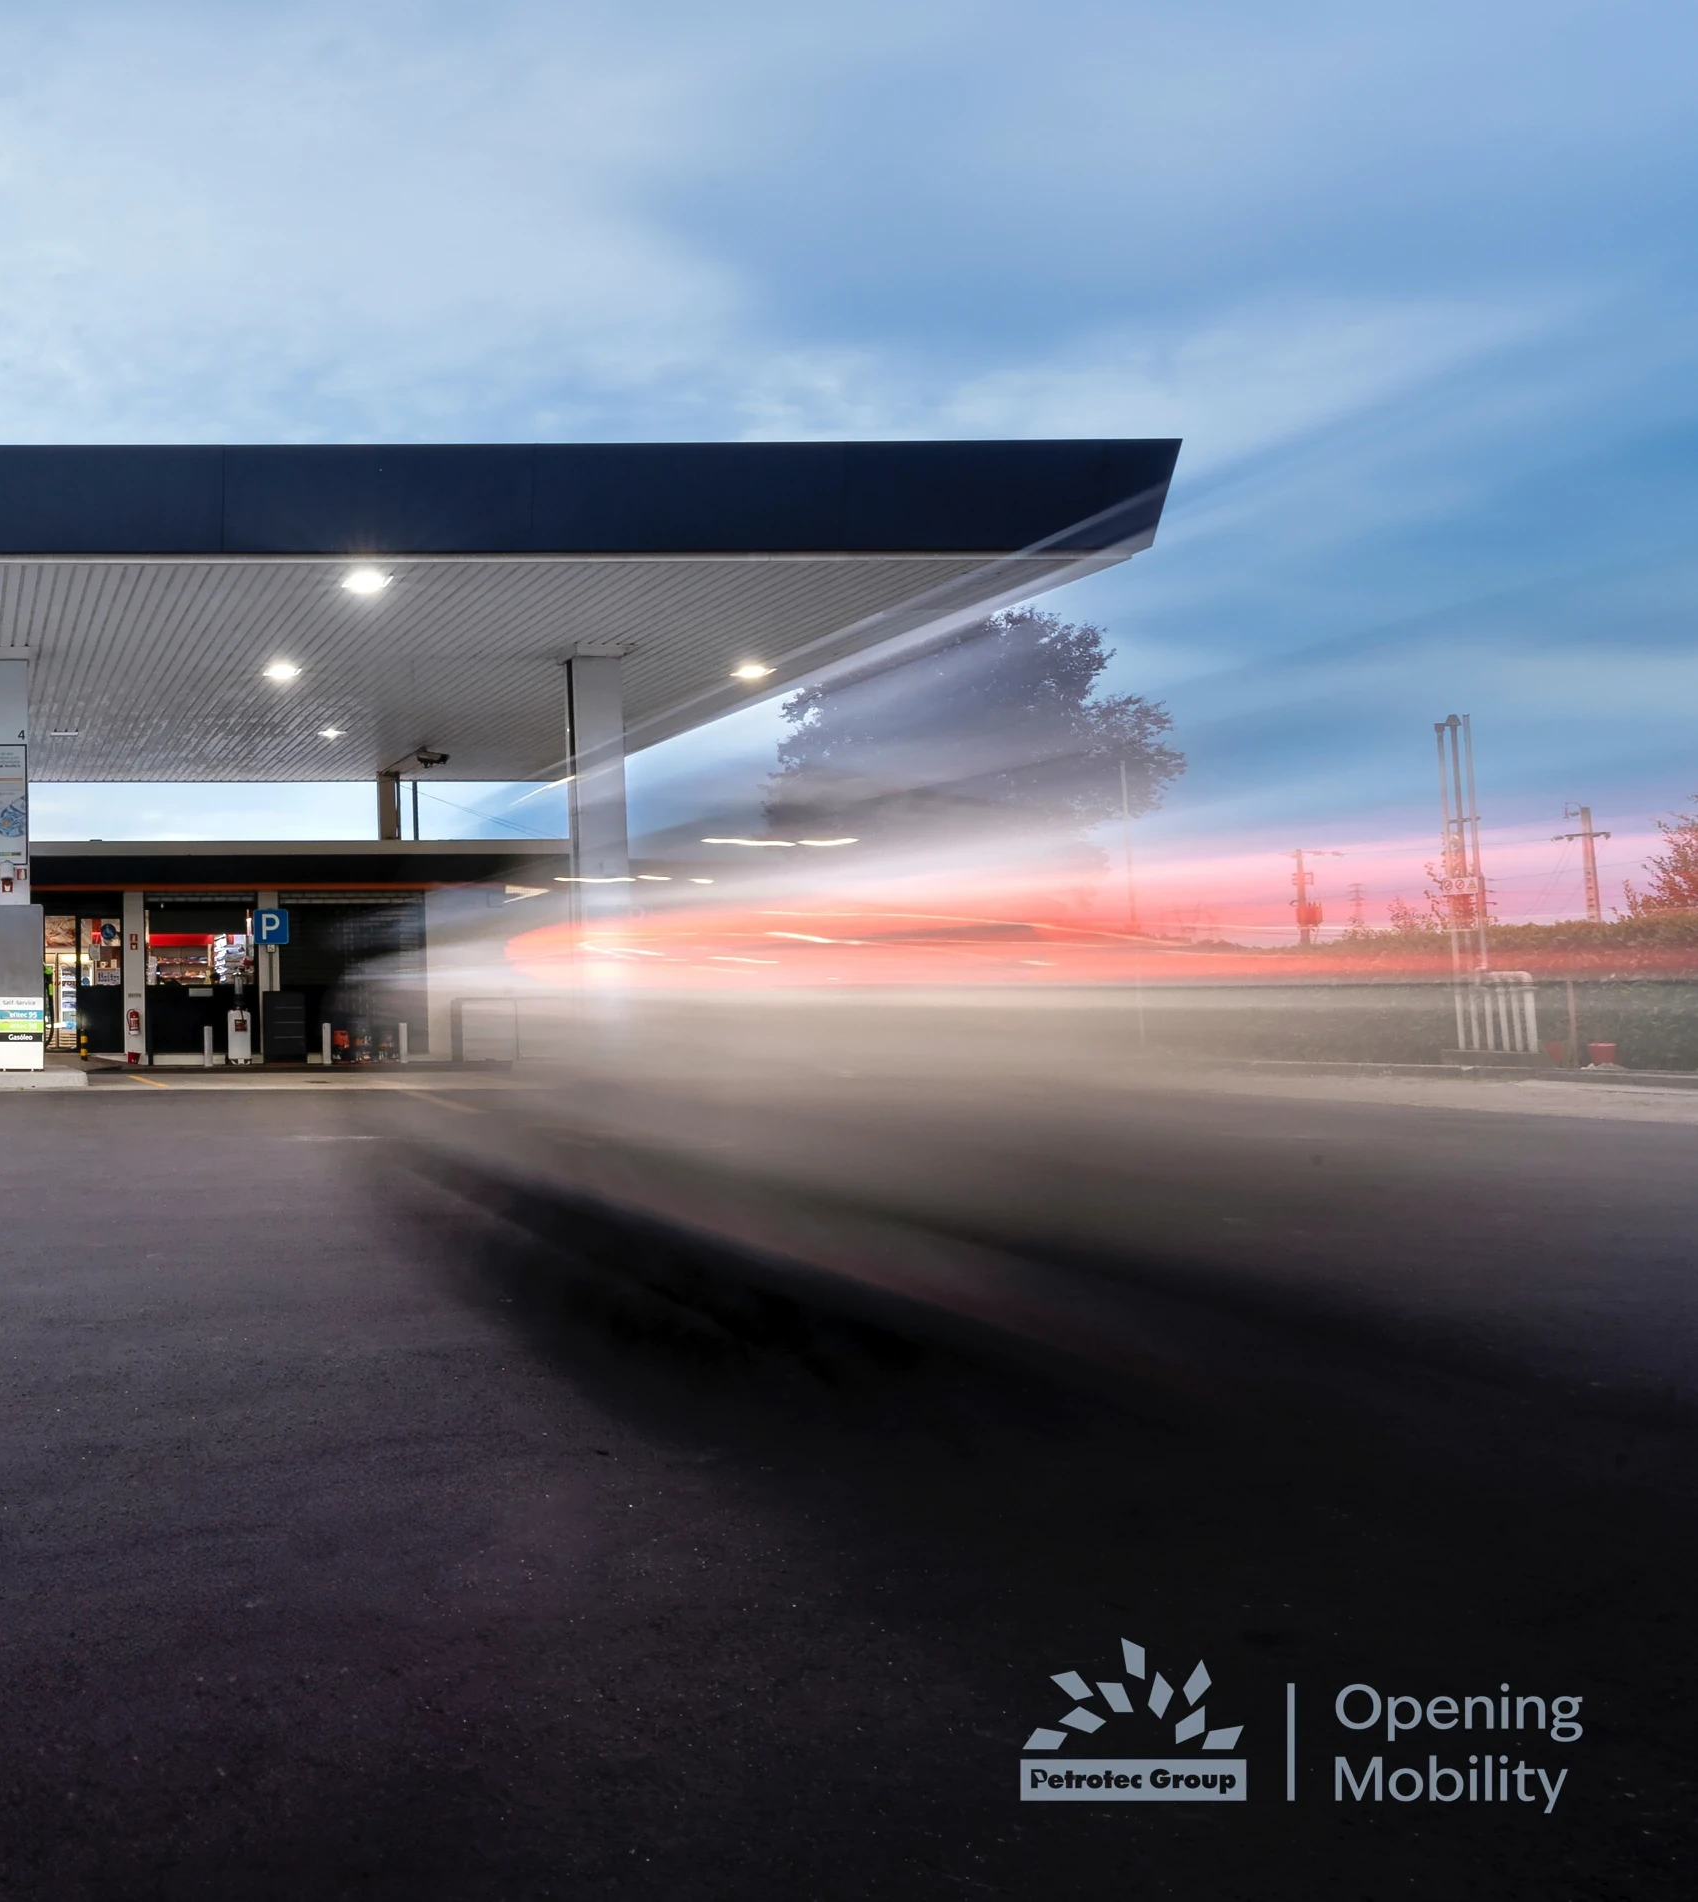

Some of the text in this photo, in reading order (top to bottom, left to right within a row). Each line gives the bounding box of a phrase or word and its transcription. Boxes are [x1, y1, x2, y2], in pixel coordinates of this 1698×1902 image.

[18, 730, 26, 740] 4
[262, 913, 280, 940] P
[8, 1033, 33, 1041] Gasóleo
